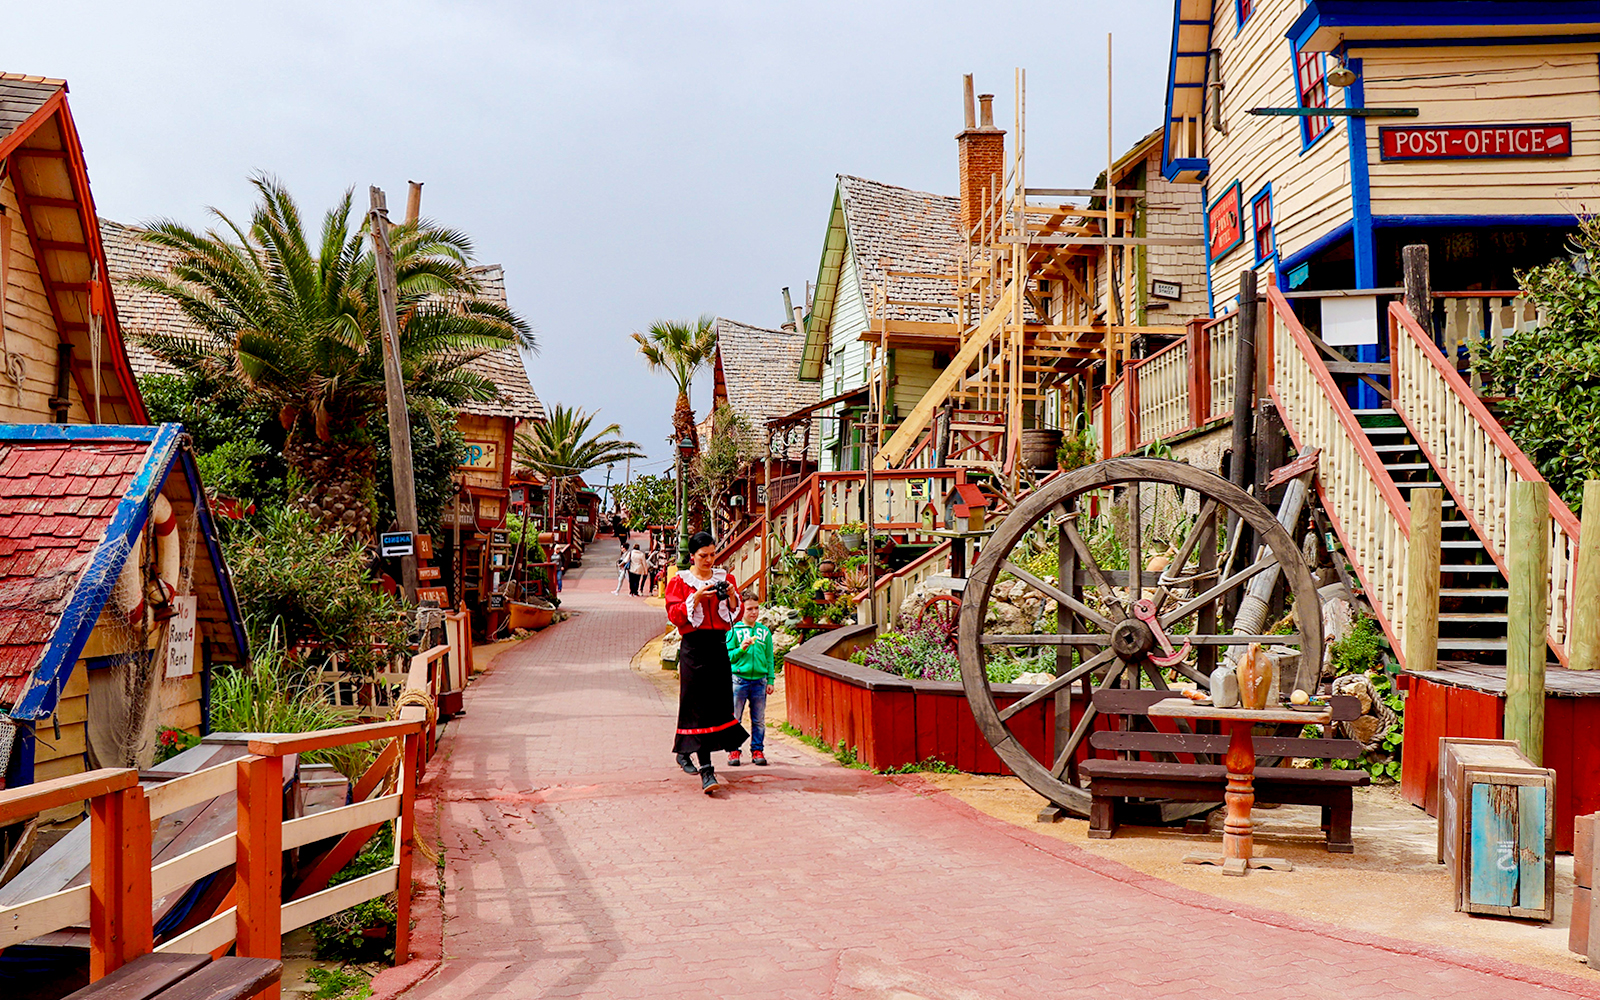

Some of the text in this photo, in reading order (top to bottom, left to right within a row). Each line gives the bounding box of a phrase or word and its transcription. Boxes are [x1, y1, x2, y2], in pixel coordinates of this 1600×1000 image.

[384, 535, 411, 544] CINEMA
[177, 602, 188, 619] No
[736, 627, 769, 643] FRSY
[170, 647, 187, 666] Rent
